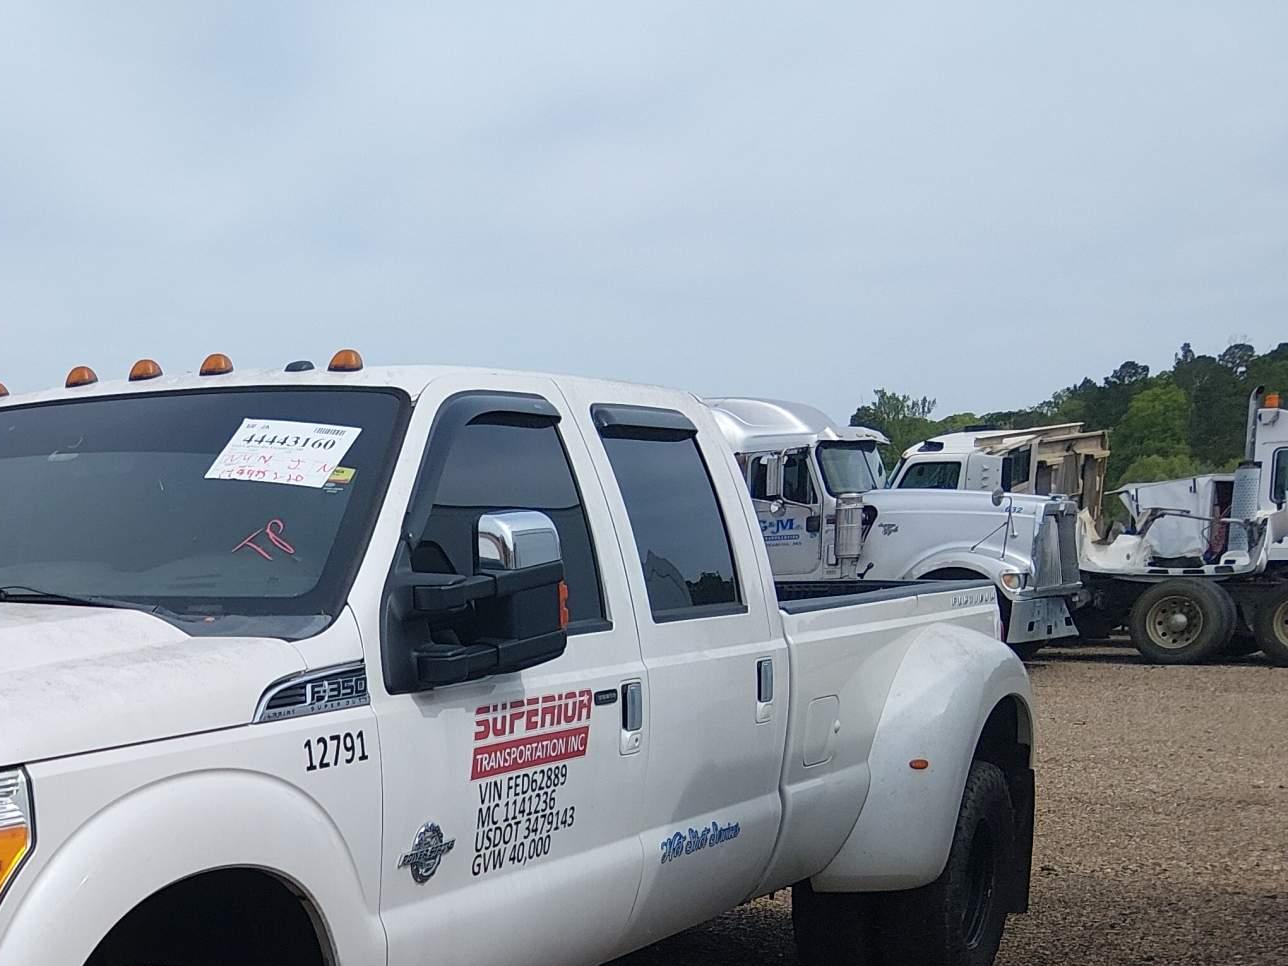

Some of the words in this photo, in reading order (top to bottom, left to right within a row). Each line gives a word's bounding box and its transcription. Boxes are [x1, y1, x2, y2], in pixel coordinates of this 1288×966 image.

[243, 433, 336, 451] 44443160
[475, 690, 593, 741] SUPERIOR
[304, 730, 369, 771] 12791
[475, 739, 566, 773] TRANSPORTATION
[567, 733, 585, 753] INC
[479, 779, 502, 805] VIN
[506, 764, 568, 798] FED62889
[475, 820, 521, 853] USDOT
[523, 806, 575, 840] 3479143
[477, 803, 500, 829] MC
[503, 789, 556, 822] 1141236
[472, 847, 506, 876] GVW
[509, 834, 551, 866] 40,000
